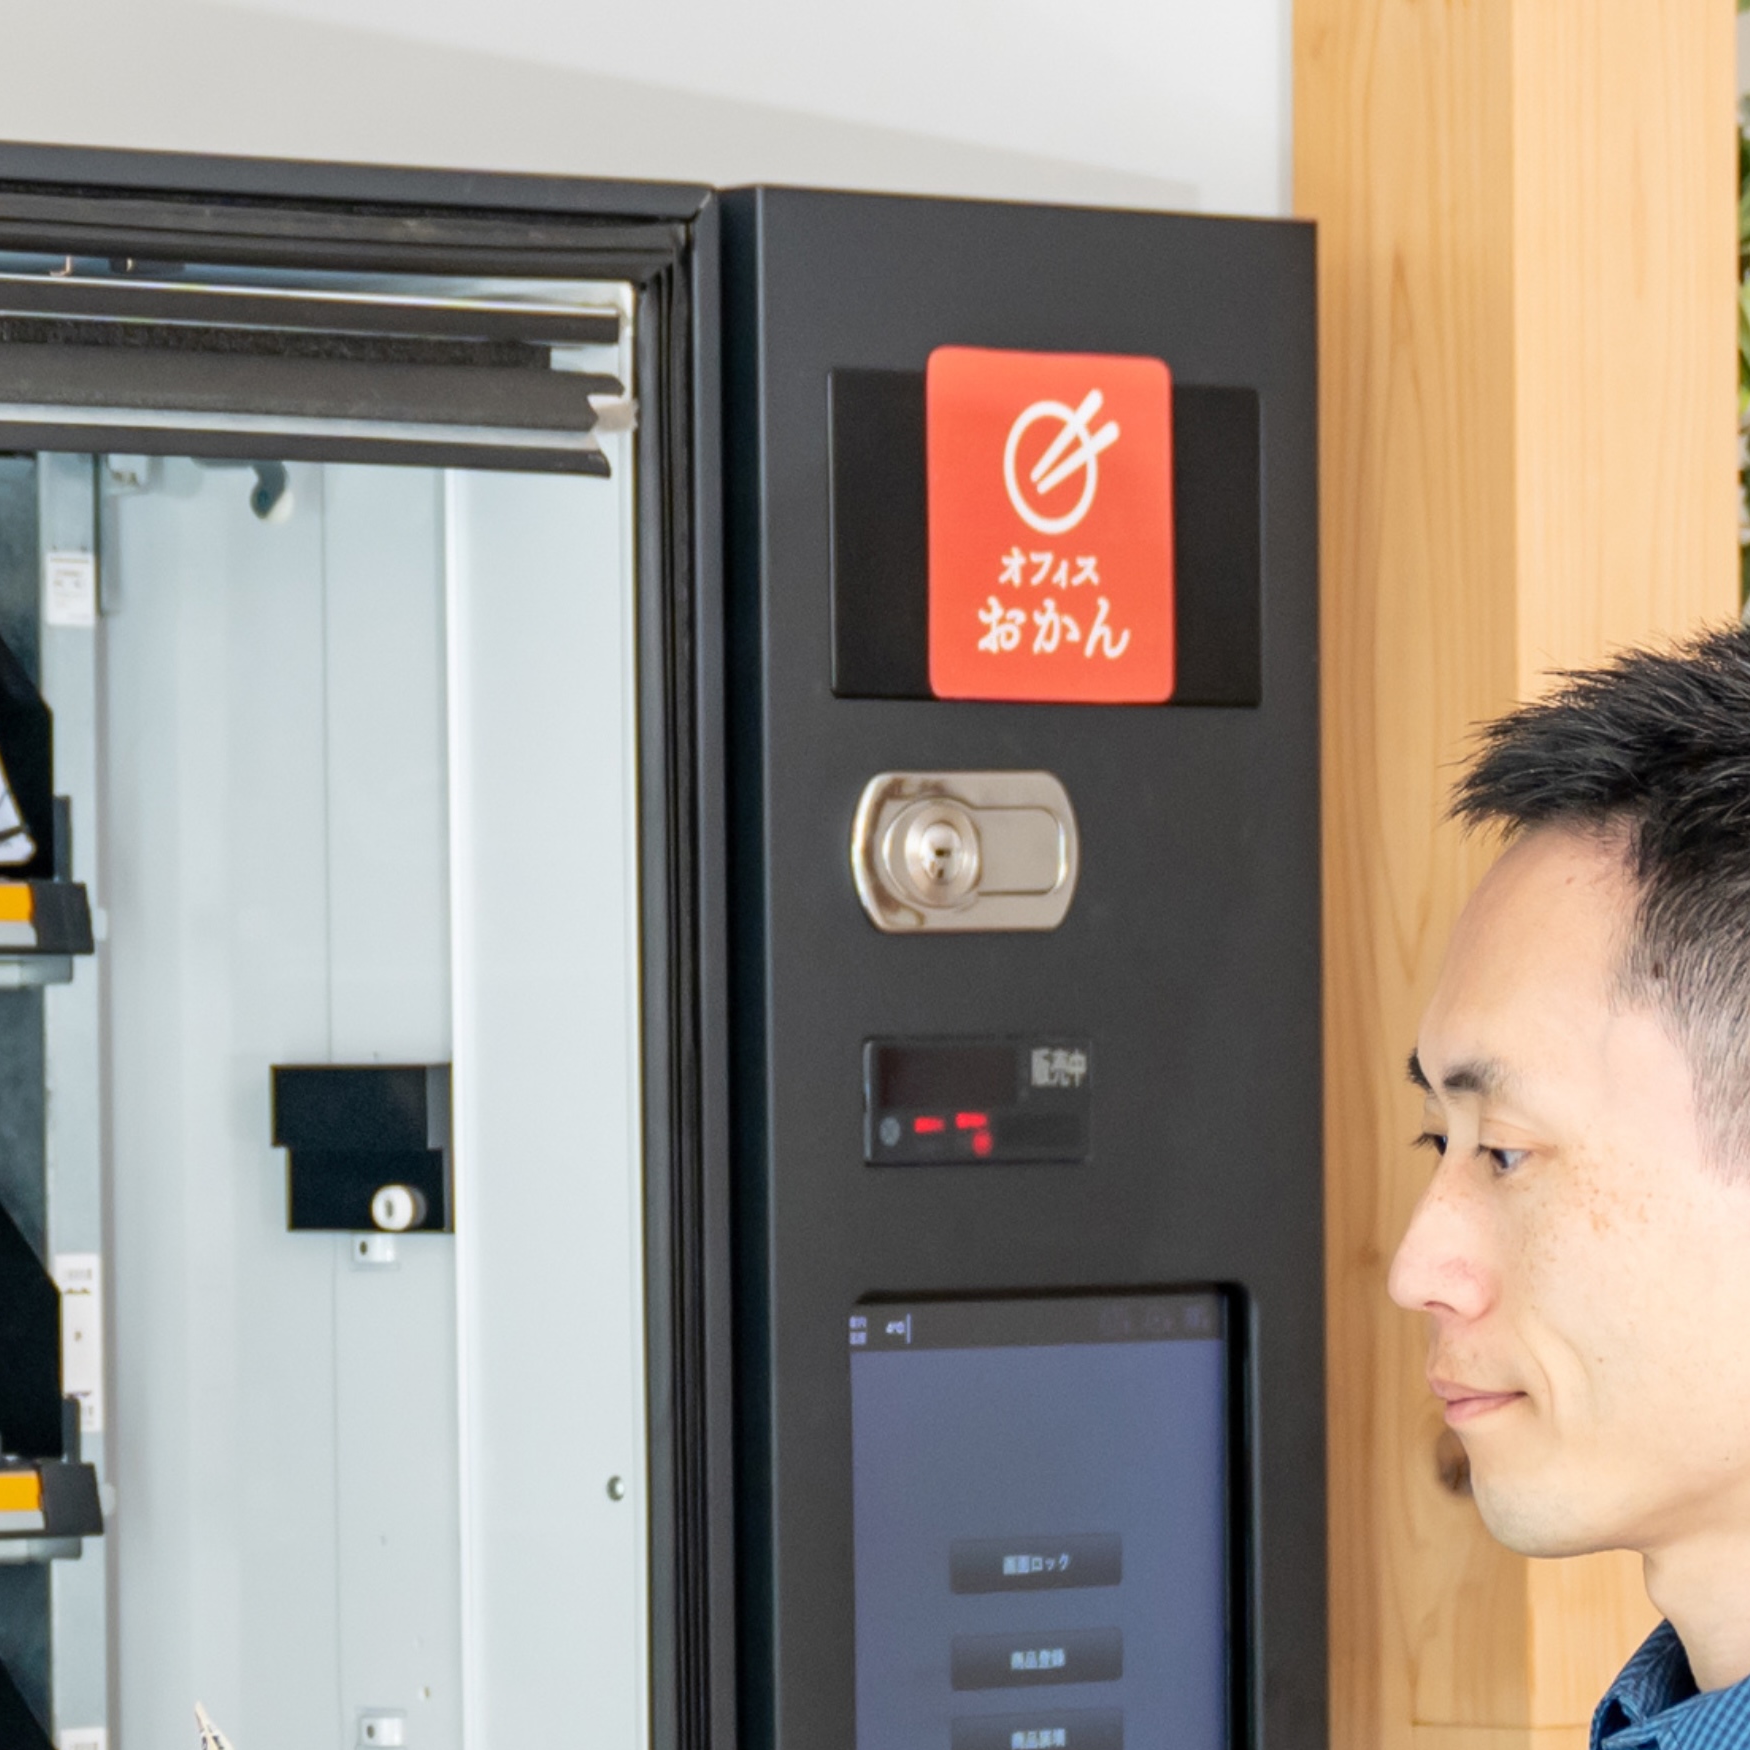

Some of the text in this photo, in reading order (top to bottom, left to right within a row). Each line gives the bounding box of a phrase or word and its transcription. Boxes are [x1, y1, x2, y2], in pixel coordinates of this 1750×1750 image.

[998, 546, 1100, 590] オフィス
[977, 596, 1130, 660] おかん
[1030, 1048, 1088, 1088] 販売中
